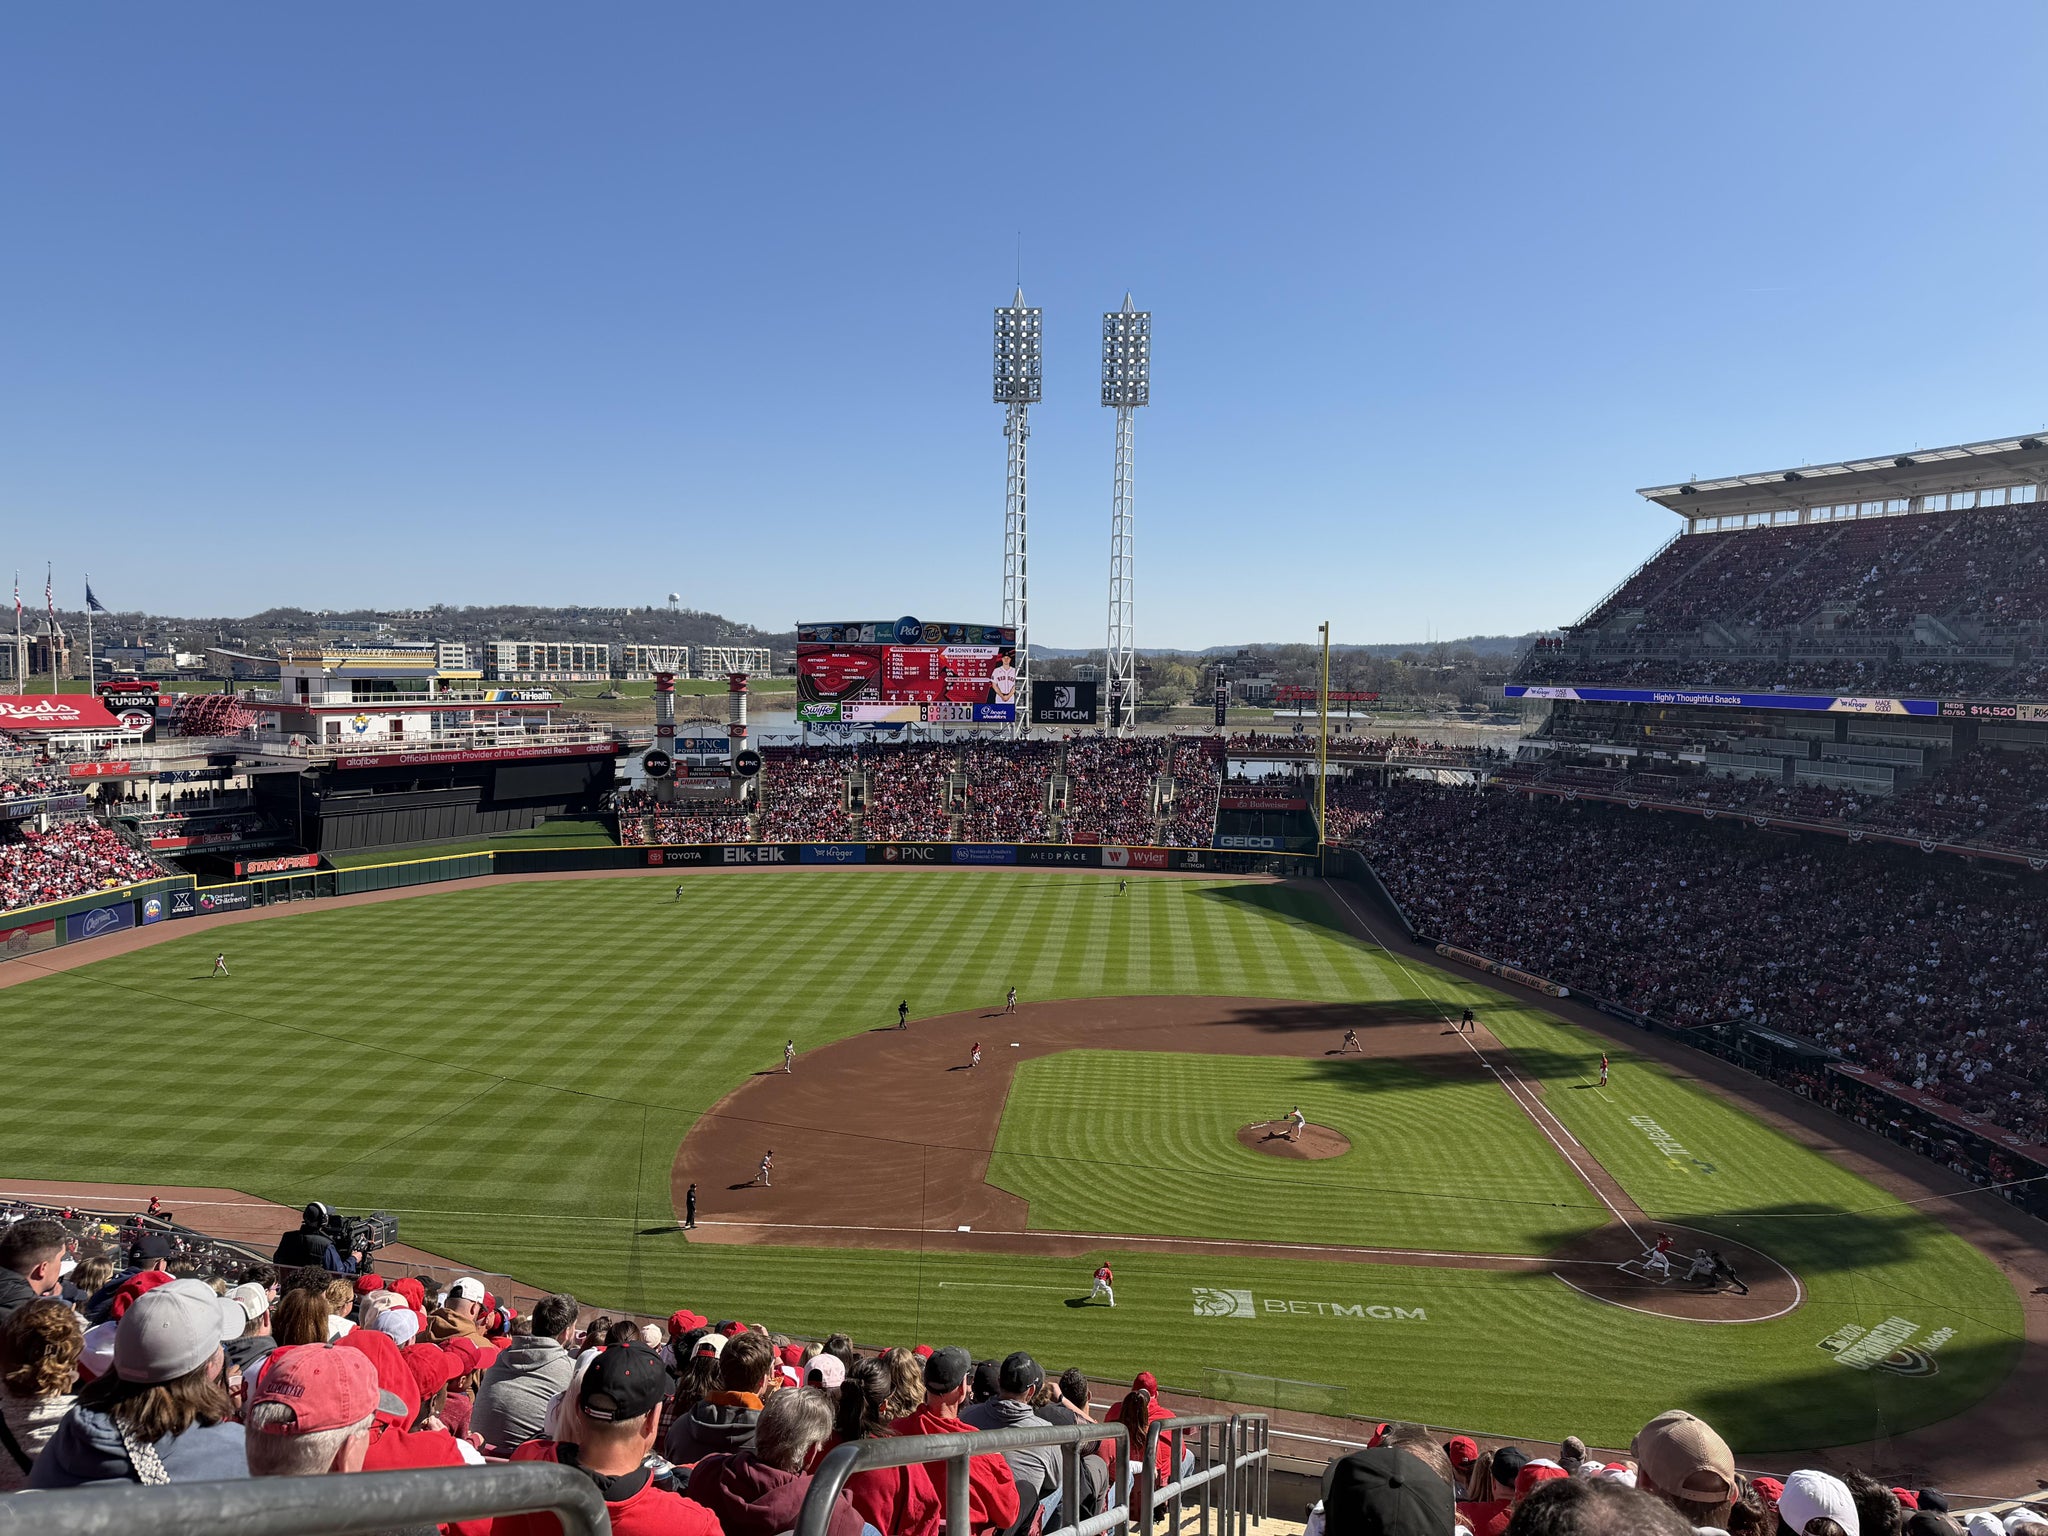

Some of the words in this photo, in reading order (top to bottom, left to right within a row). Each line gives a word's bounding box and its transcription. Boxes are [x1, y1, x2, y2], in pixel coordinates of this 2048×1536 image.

[900, 626, 920, 636] P&G
[109, 697, 154, 706] TUNDRA
[519, 691, 552, 701] TriHealth
[1653, 693, 1675, 703] Highly
[1676, 694, 1714, 704] Thoughtful
[1714, 695, 1741, 704] Snacks
[0, 700, 79, 718] Reds
[801, 703, 836, 717] Swiffer
[1848, 699, 1868, 712] Kroger
[1971, 705, 2016, 717] $14,520
[1040, 710, 1089, 720] BETMGM
[1943, 709, 1966, 717] 50/50
[124, 717, 153, 725] REDS
[810, 722, 848, 732] BEACON
[696, 740, 720, 749] PNC
[346, 757, 379, 768] altafiber
[400, 754, 430, 763] Official
[430, 752, 461, 762] Internet
[462, 751, 493, 760] Provider
[494, 750, 502, 758] of
[503, 749, 516, 758] the
[516, 747, 552, 757] Cincinnati
[553, 747, 572, 755] Reds.
[586, 744, 611, 753] altafiber
[188, 768, 222, 778] XAVIER
[57, 797, 78, 810] ROSE
[1249, 800, 1289, 809] Budweiser
[1220, 837, 1274, 848] GEICO
[666, 852, 702, 861] TOYOTA
[826, 846, 853, 861] Kroger
[901, 847, 935, 860] PNC
[1030, 851, 1087, 861] MEDPACE
[1133, 852, 1164, 864] Wyler
[247, 859, 276, 873] STAR
[285, 856, 310, 869] FIRE
[215, 896, 247, 905] Children's
[1263, 1299, 1428, 1321] BETMGM
[1833, 1328, 1904, 1371] OPENING
[1875, 1315, 1921, 1342] DAY
[1918, 1327, 1958, 1352] Adobe
